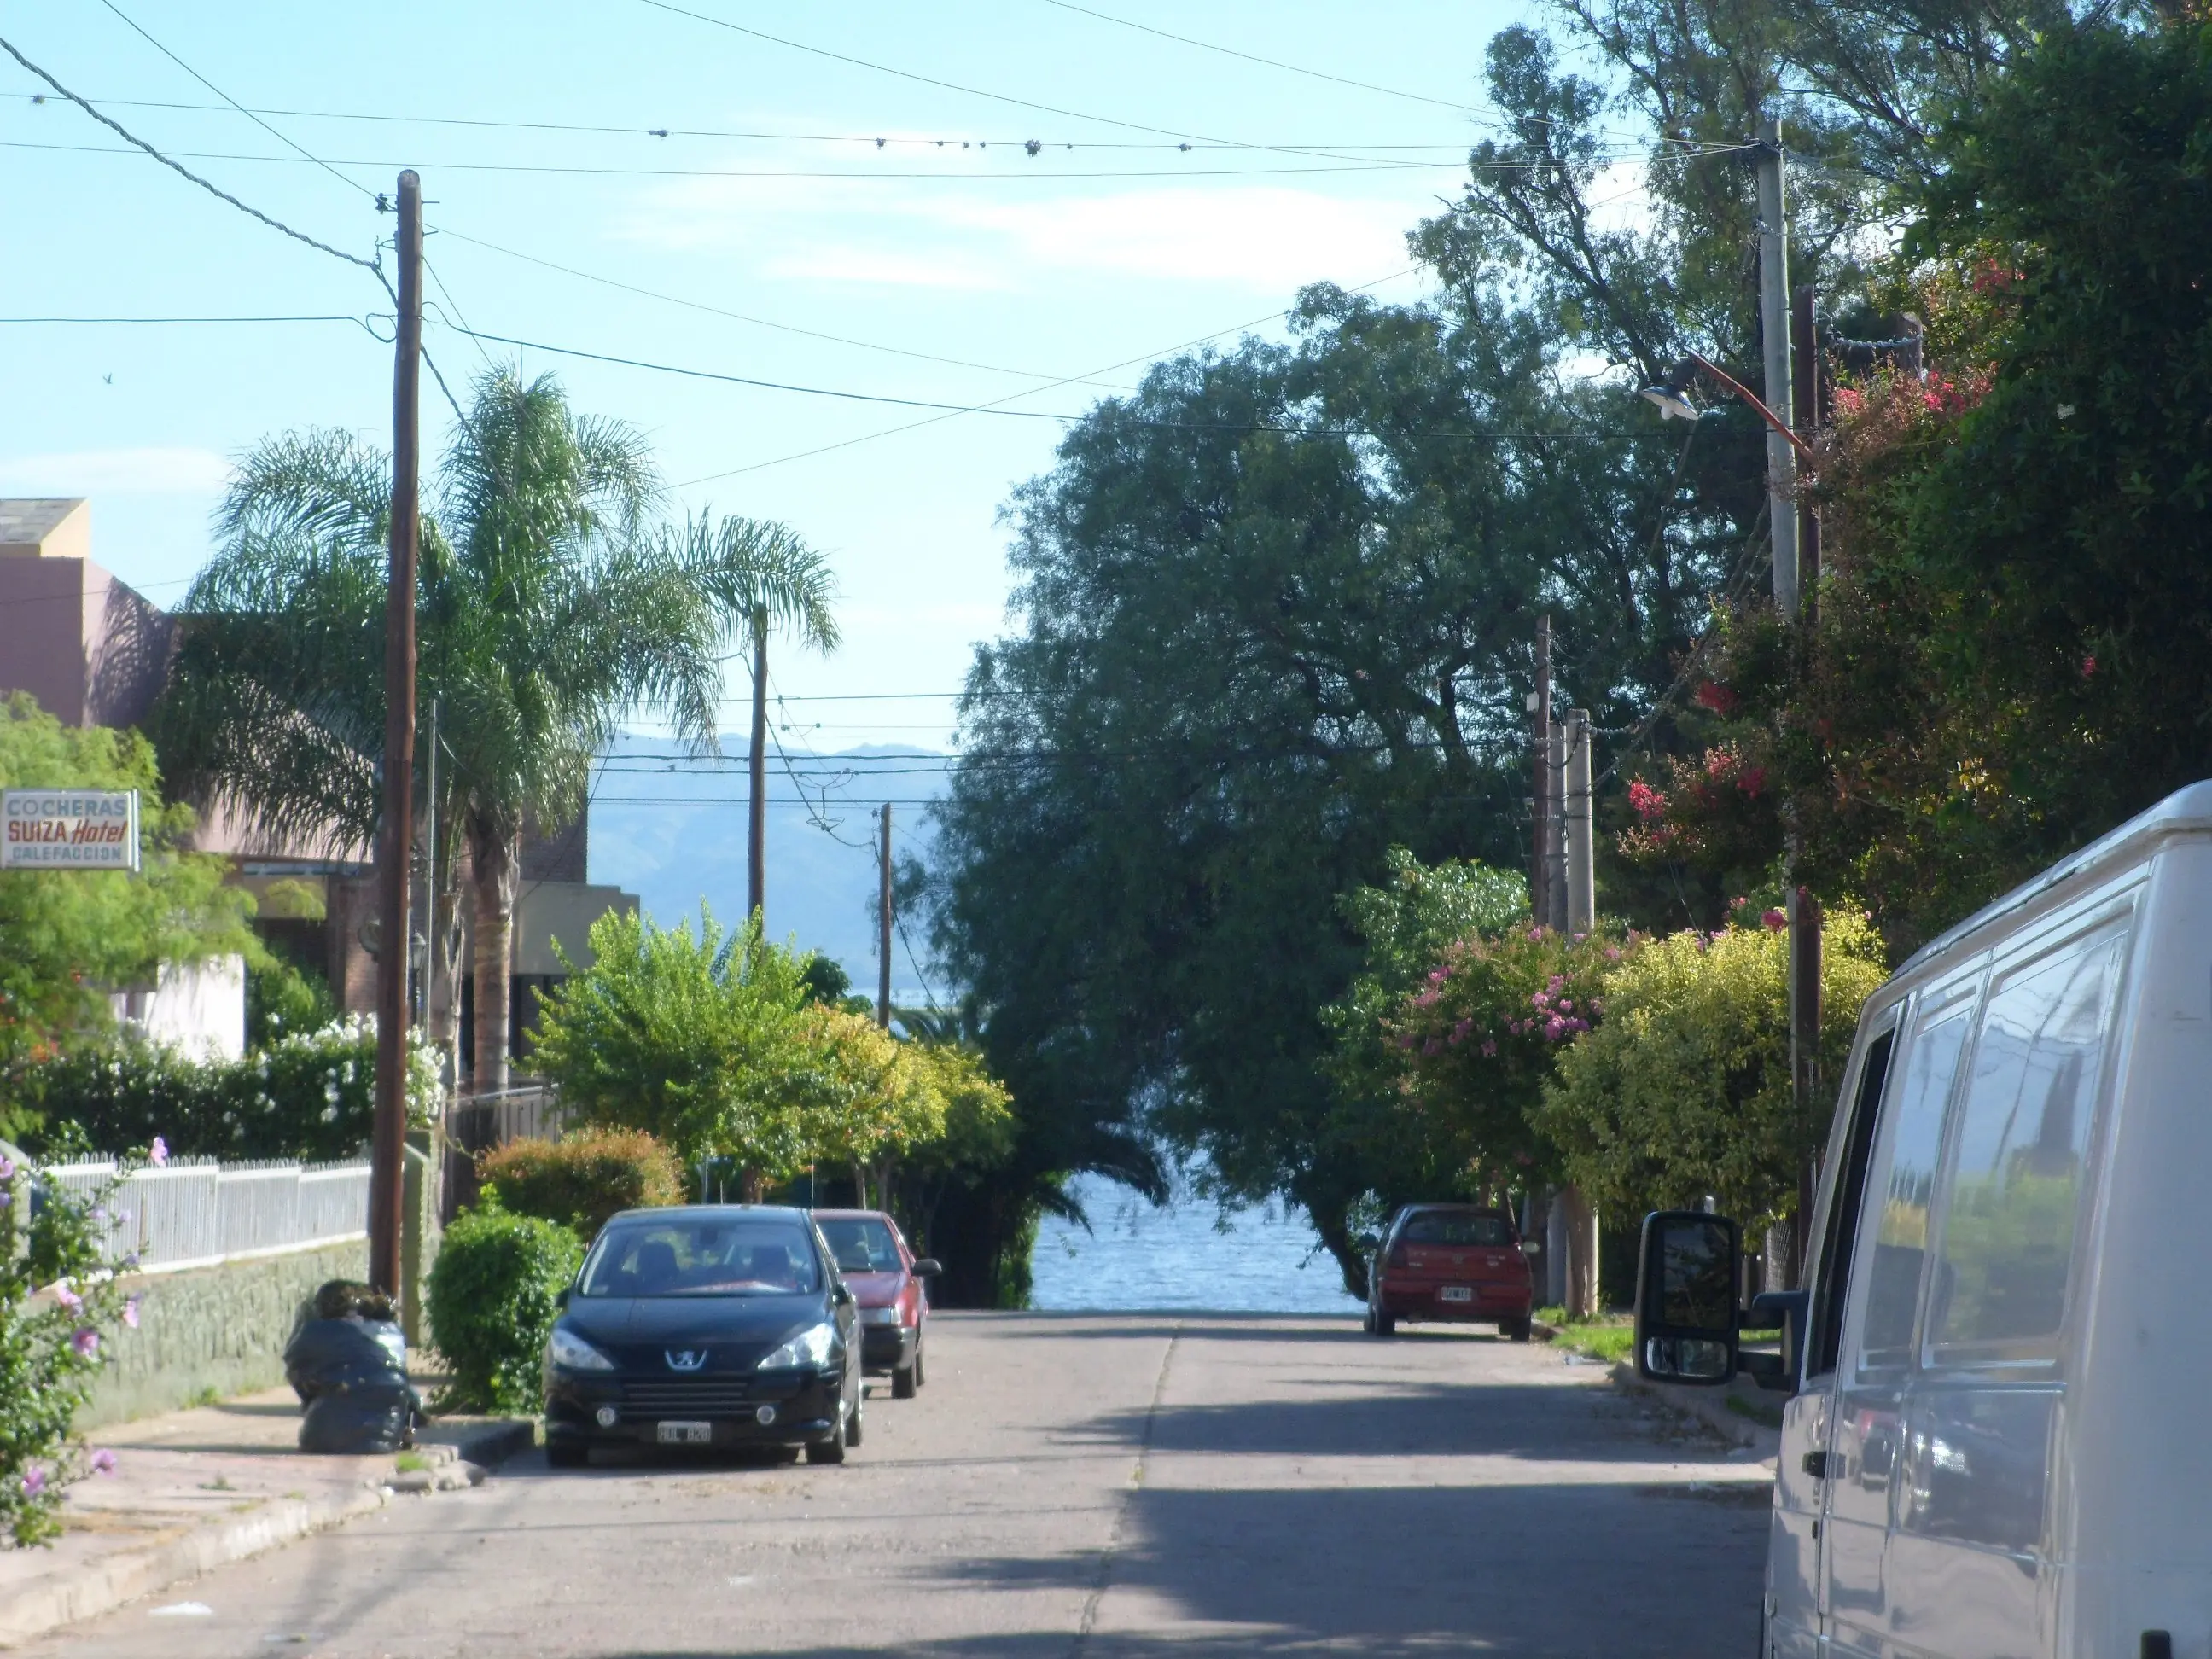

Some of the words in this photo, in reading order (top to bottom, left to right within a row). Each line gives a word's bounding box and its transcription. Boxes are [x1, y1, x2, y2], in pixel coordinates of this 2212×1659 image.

[8, 800, 125, 816] COCHERAS
[9, 820, 67, 842] SUIZA
[72, 819, 128, 845] Hotel
[13, 847, 121, 860] CALEFACCION
